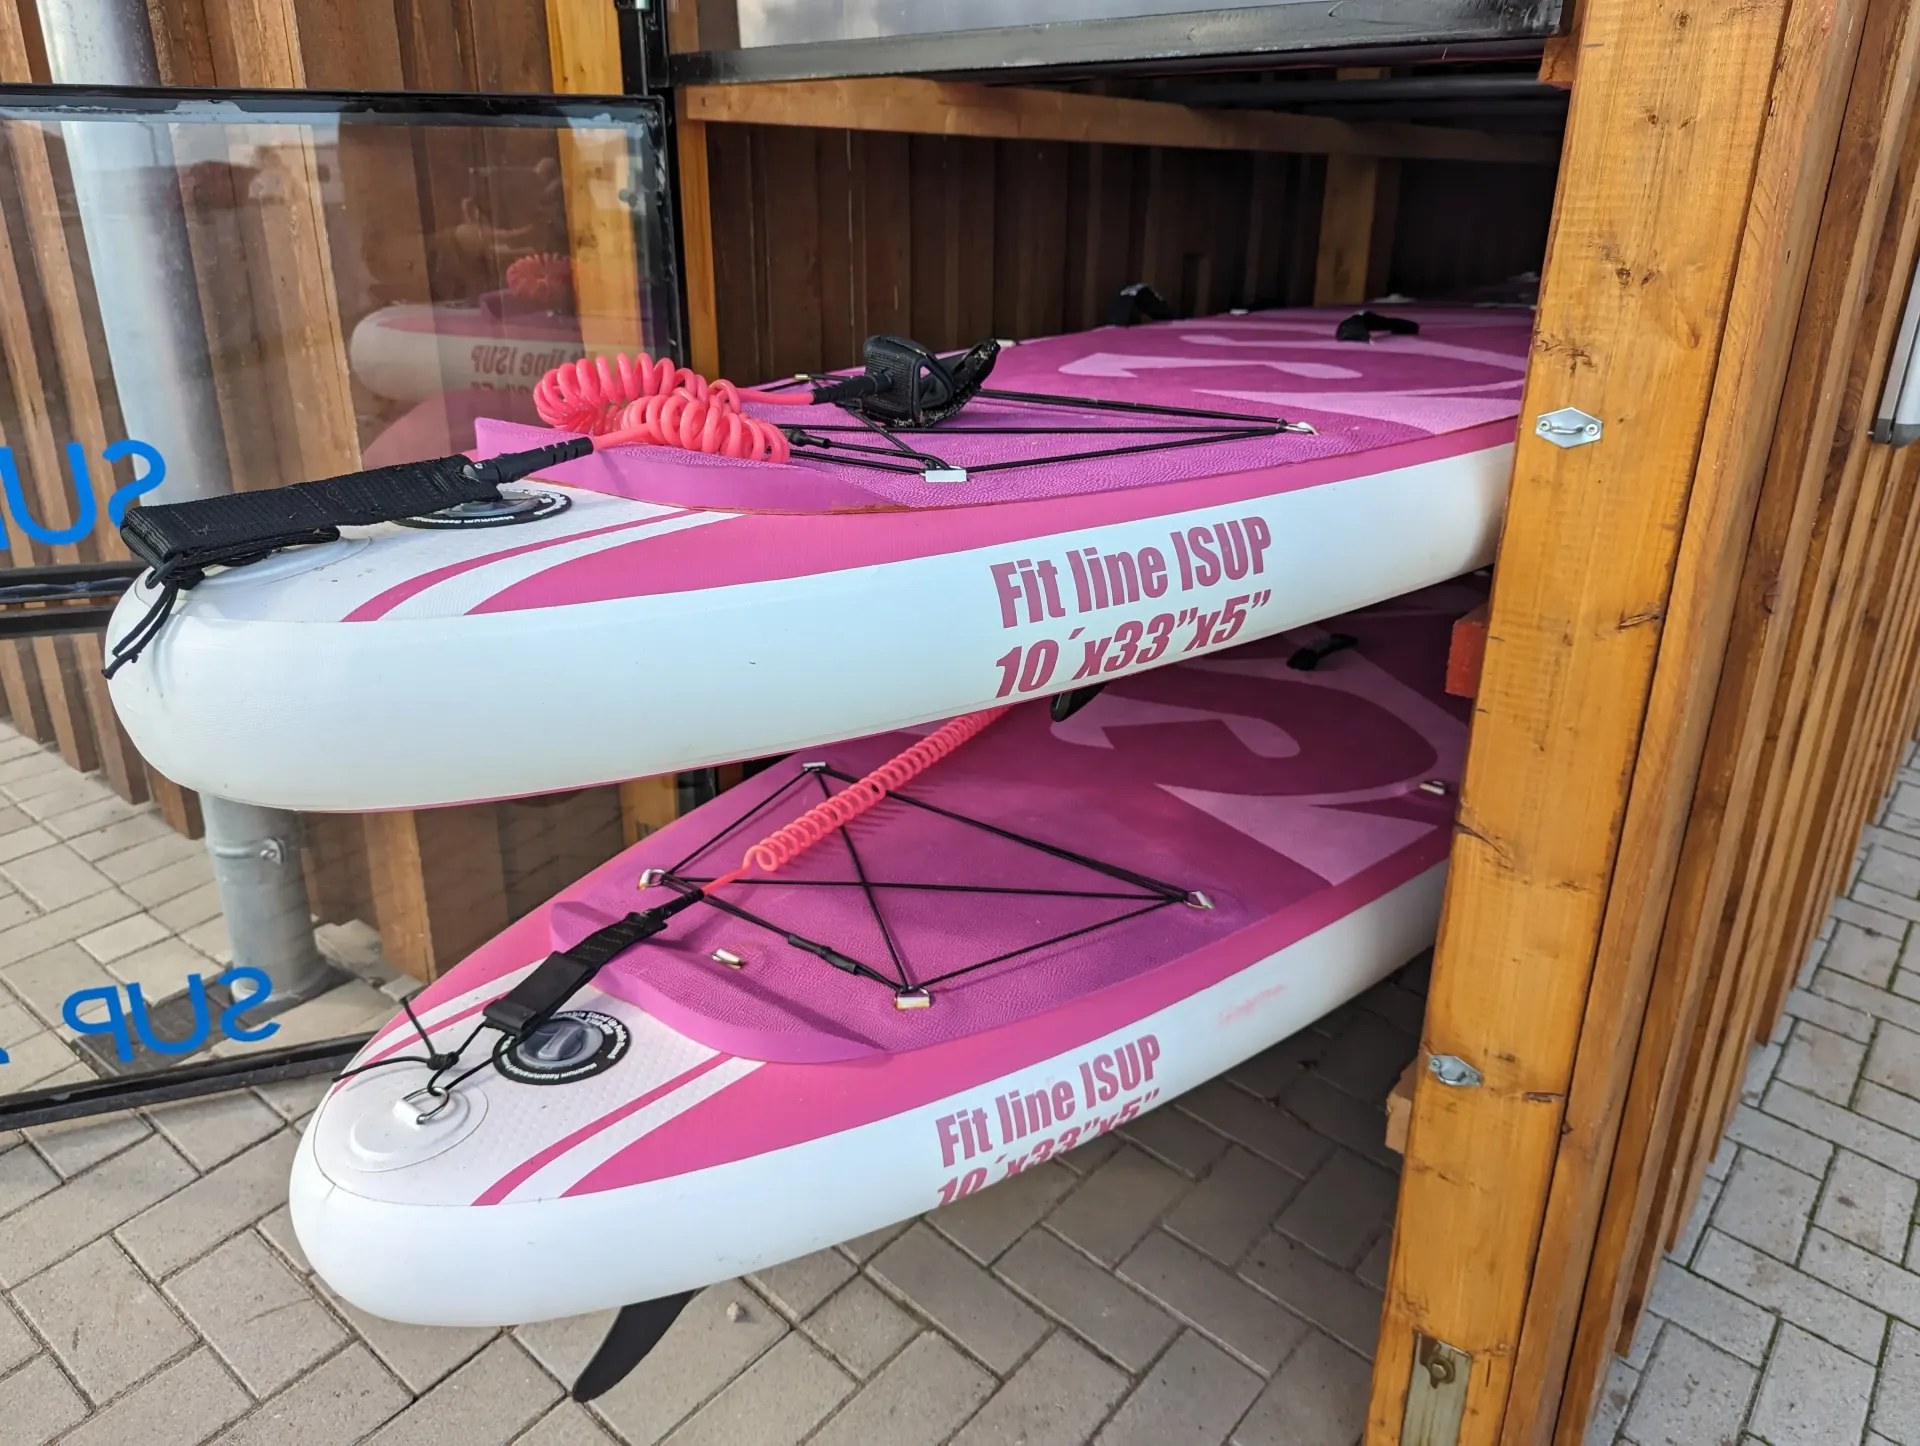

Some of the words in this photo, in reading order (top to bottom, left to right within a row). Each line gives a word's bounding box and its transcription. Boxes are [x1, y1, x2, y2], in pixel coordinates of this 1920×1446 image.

[990, 558, 1067, 629] Fit
[1065, 546, 1169, 614] line
[1169, 516, 1272, 592] ISUP
[935, 1107, 994, 1169] Fit
[995, 1080, 1077, 1145] line
[1078, 1034, 1161, 1110] ISUP
